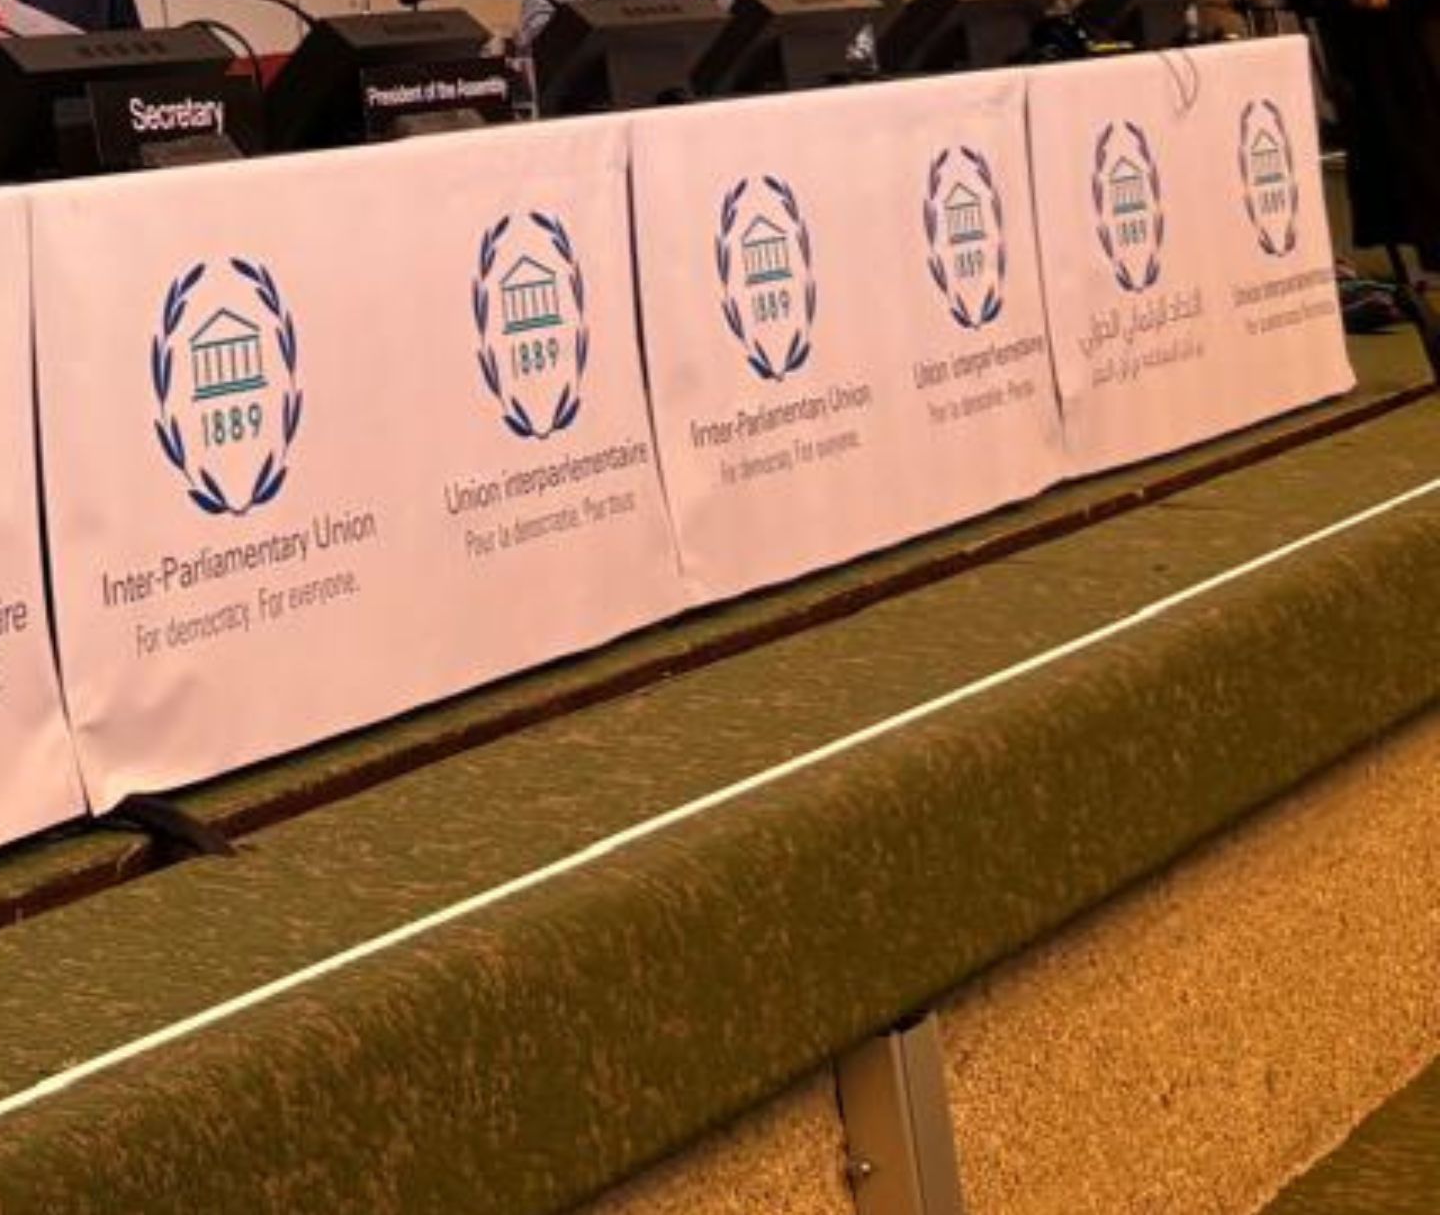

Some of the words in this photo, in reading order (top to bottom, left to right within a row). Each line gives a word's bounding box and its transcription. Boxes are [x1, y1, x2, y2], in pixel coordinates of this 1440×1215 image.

[129, 97, 223, 132] Secretary
[753, 289, 791, 324] 1889
[511, 337, 560, 379] 1889
[202, 402, 263, 447] 1889
[445, 478, 501, 515] Union
[102, 528, 310, 606] Inter-Parliamentary
[312, 511, 376, 549] Union
[136, 624, 161, 658] For
[258, 587, 285, 621] For
